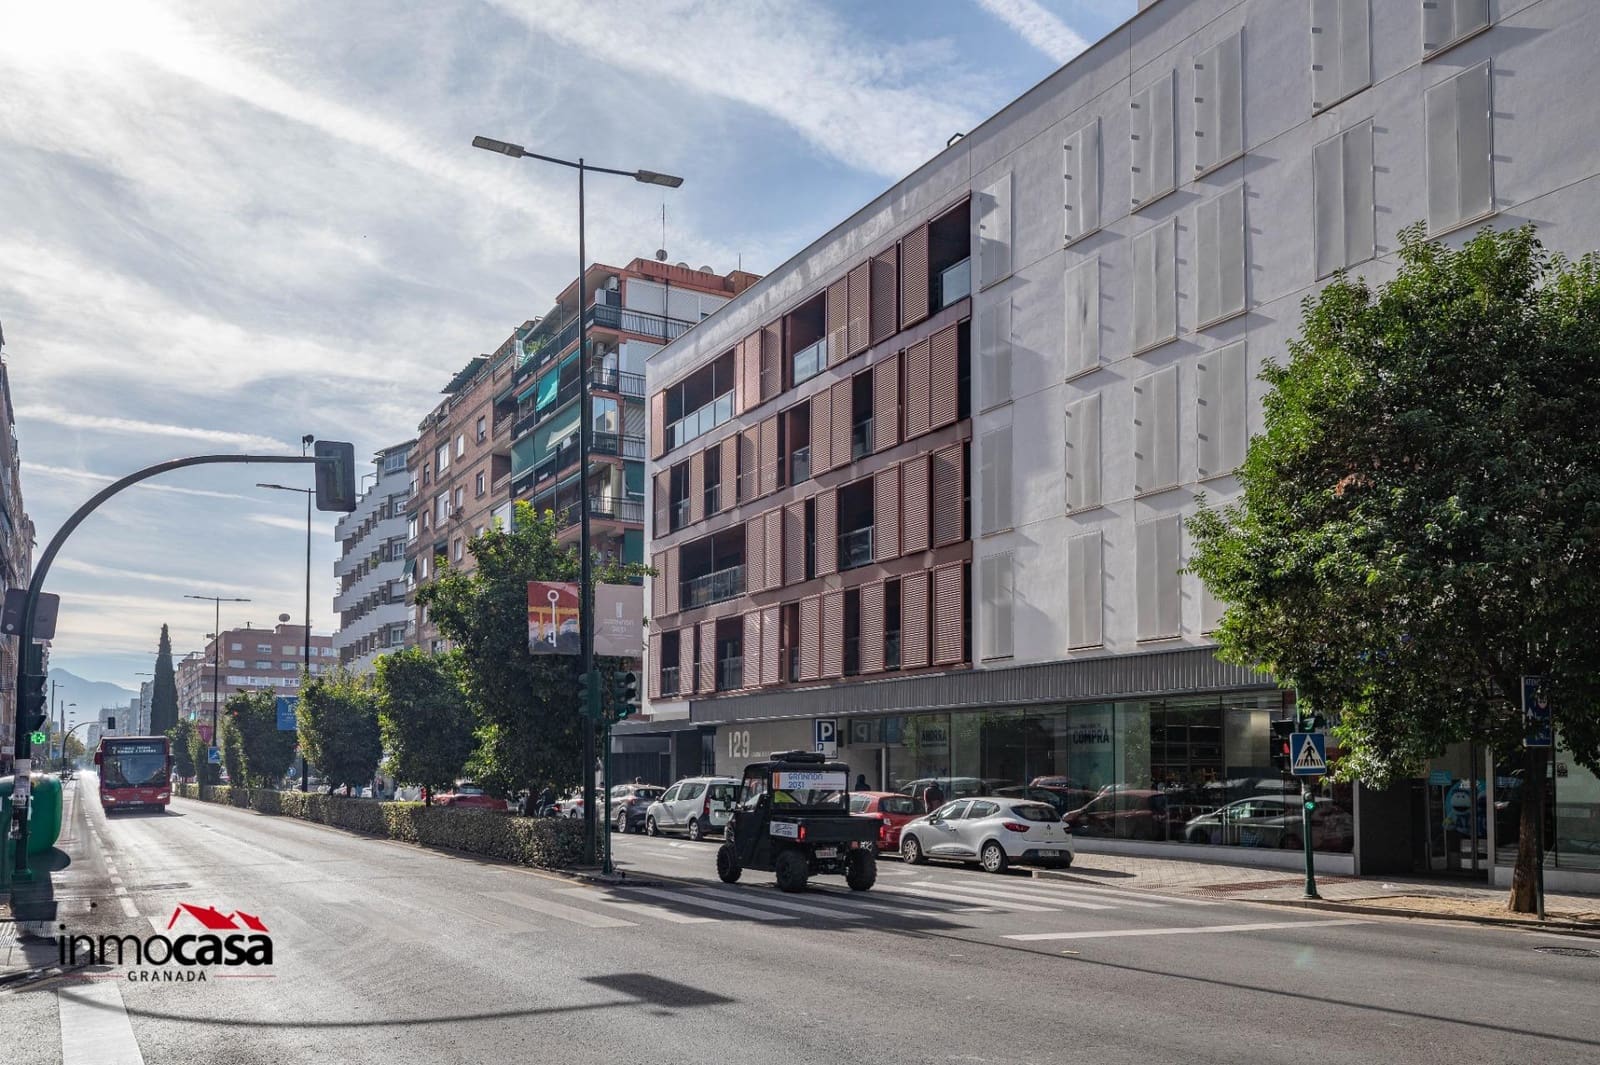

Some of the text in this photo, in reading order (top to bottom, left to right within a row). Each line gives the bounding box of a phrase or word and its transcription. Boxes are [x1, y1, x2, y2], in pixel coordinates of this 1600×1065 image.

[821, 723, 833, 741] P
[1073, 728, 1110, 744] COMPRA
[728, 731, 750, 758] 129
[788, 781, 805, 789] 2031
